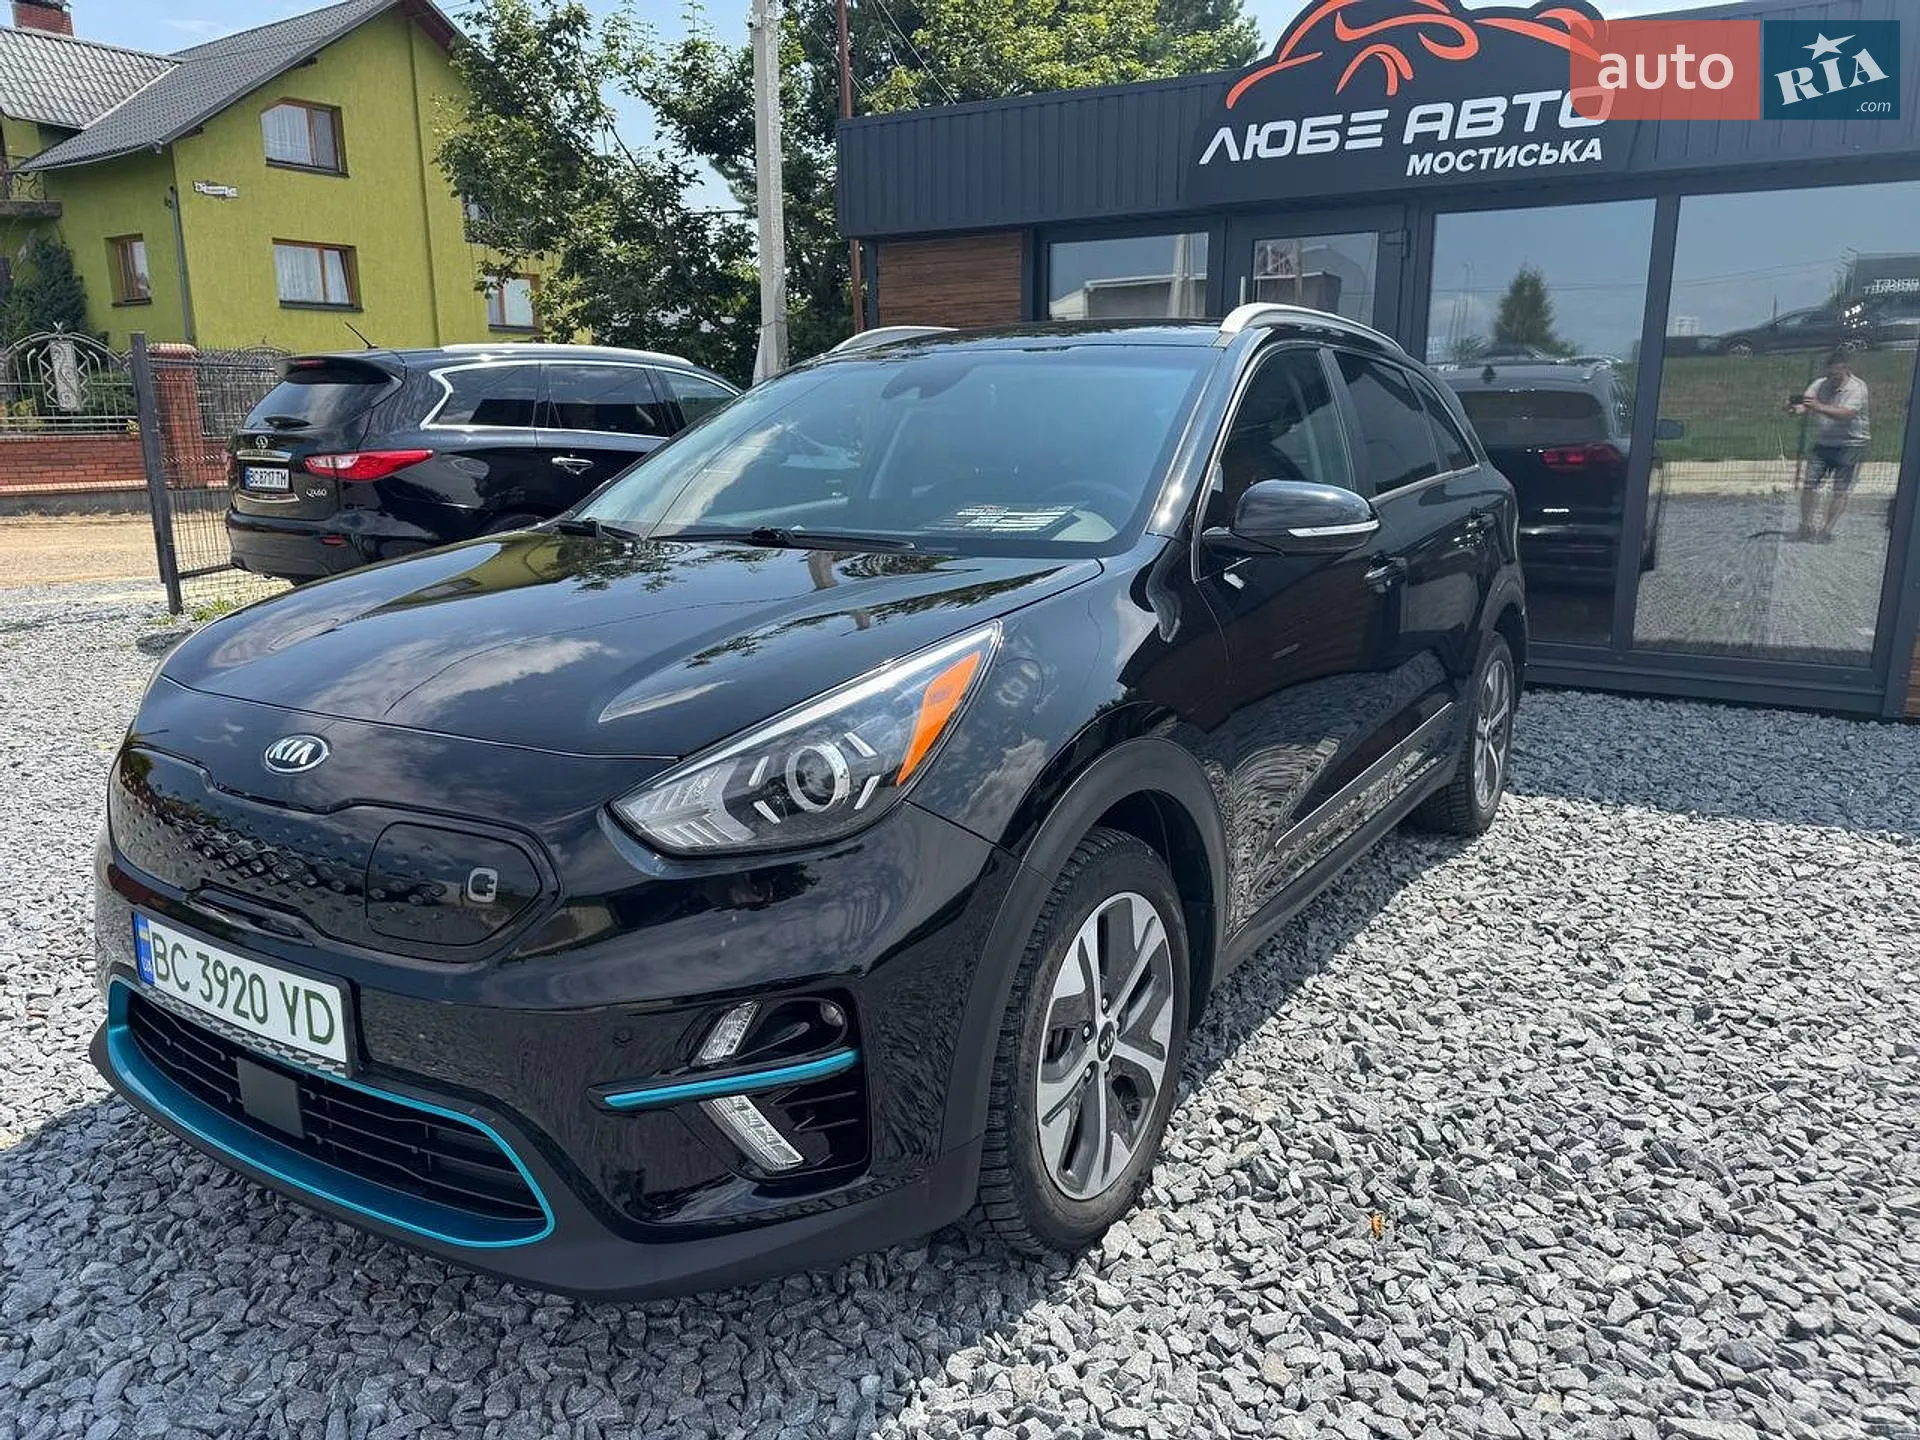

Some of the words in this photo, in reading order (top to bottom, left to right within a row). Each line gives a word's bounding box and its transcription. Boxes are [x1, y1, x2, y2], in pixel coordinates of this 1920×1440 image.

[1198, 108, 1390, 165] ЛЮБЕ
[1402, 86, 1615, 145] АВТО
[1406, 137, 1602, 176] МОСТИСЬКА
[268, 739, 316, 765] KIA
[151, 931, 190, 992] BC
[196, 951, 268, 1025] 3920
[278, 980, 335, 1045] YD
